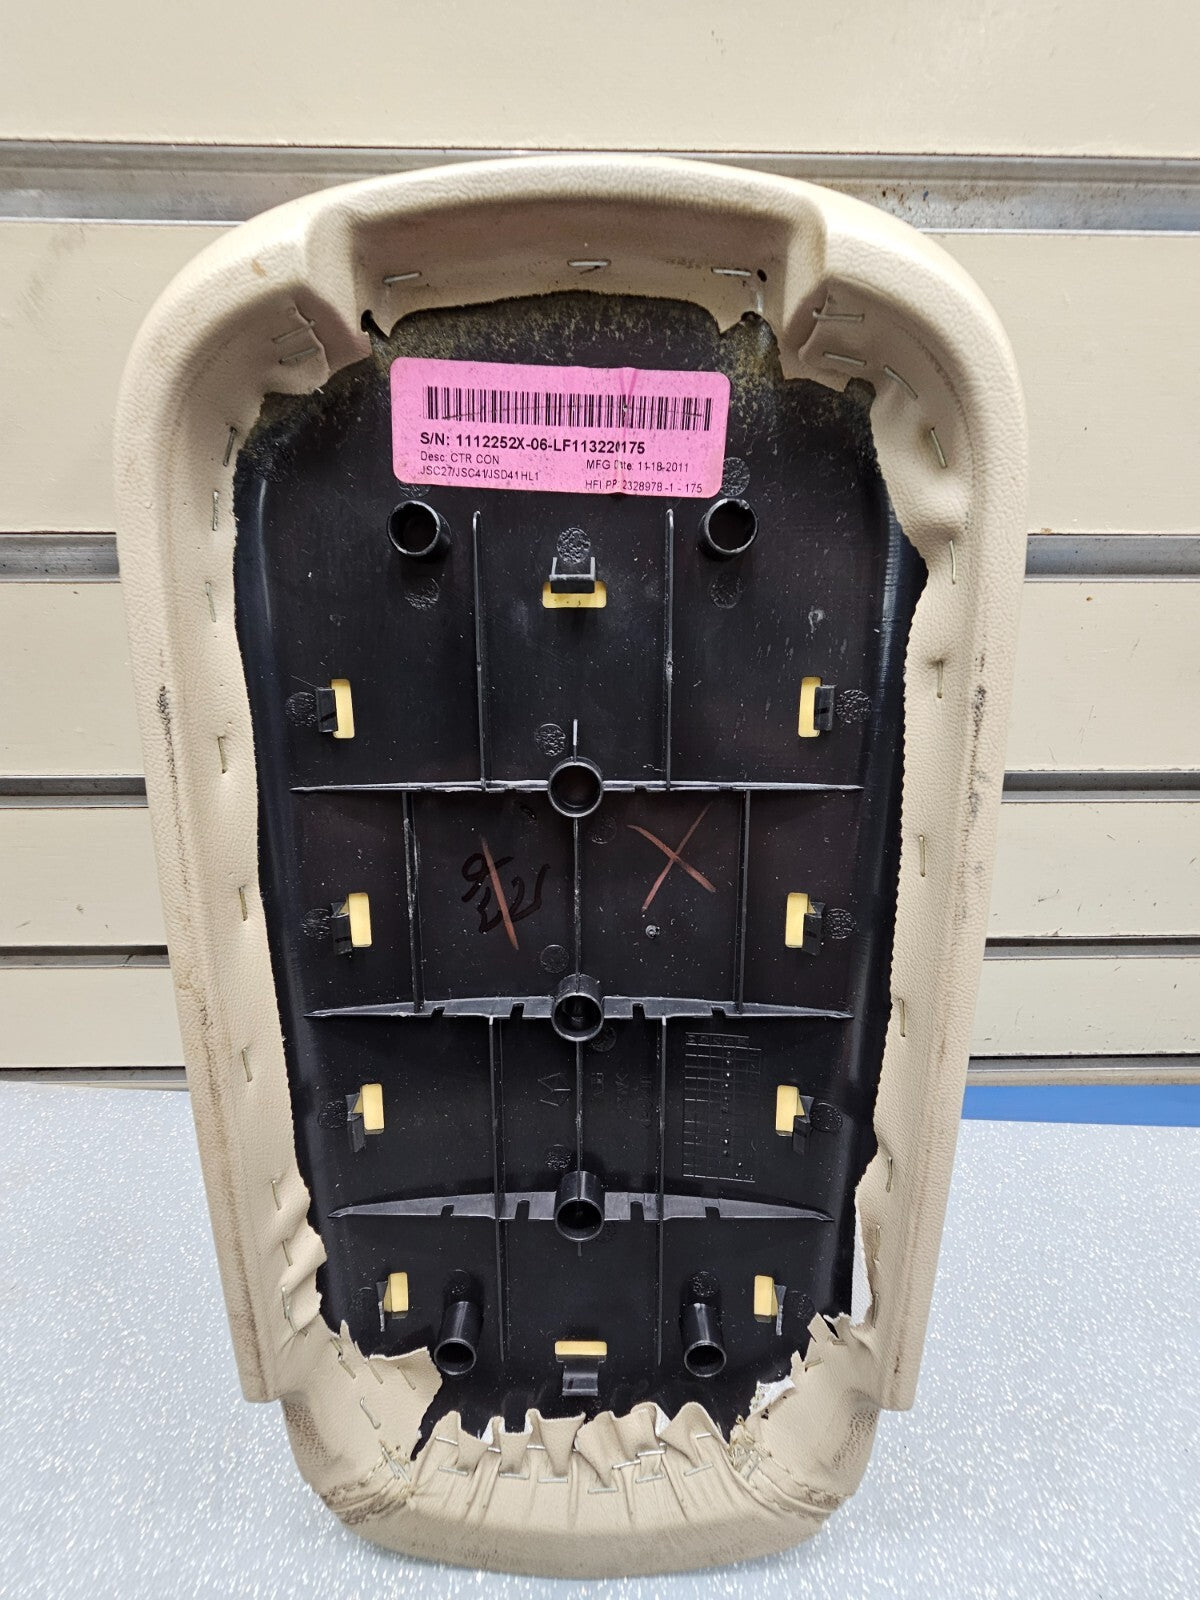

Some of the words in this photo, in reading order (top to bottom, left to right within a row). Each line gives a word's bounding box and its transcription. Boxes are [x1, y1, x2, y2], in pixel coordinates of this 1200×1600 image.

[420, 431, 450, 446] S/N:
[450, 452, 473, 464] CTR
[476, 454, 500, 465] CON
[586, 459, 611, 470] MFG
[638, 461, 689, 473] 11-18-2011
[585, 479, 602, 490] HFI
[685, 483, 703, 494] 175
